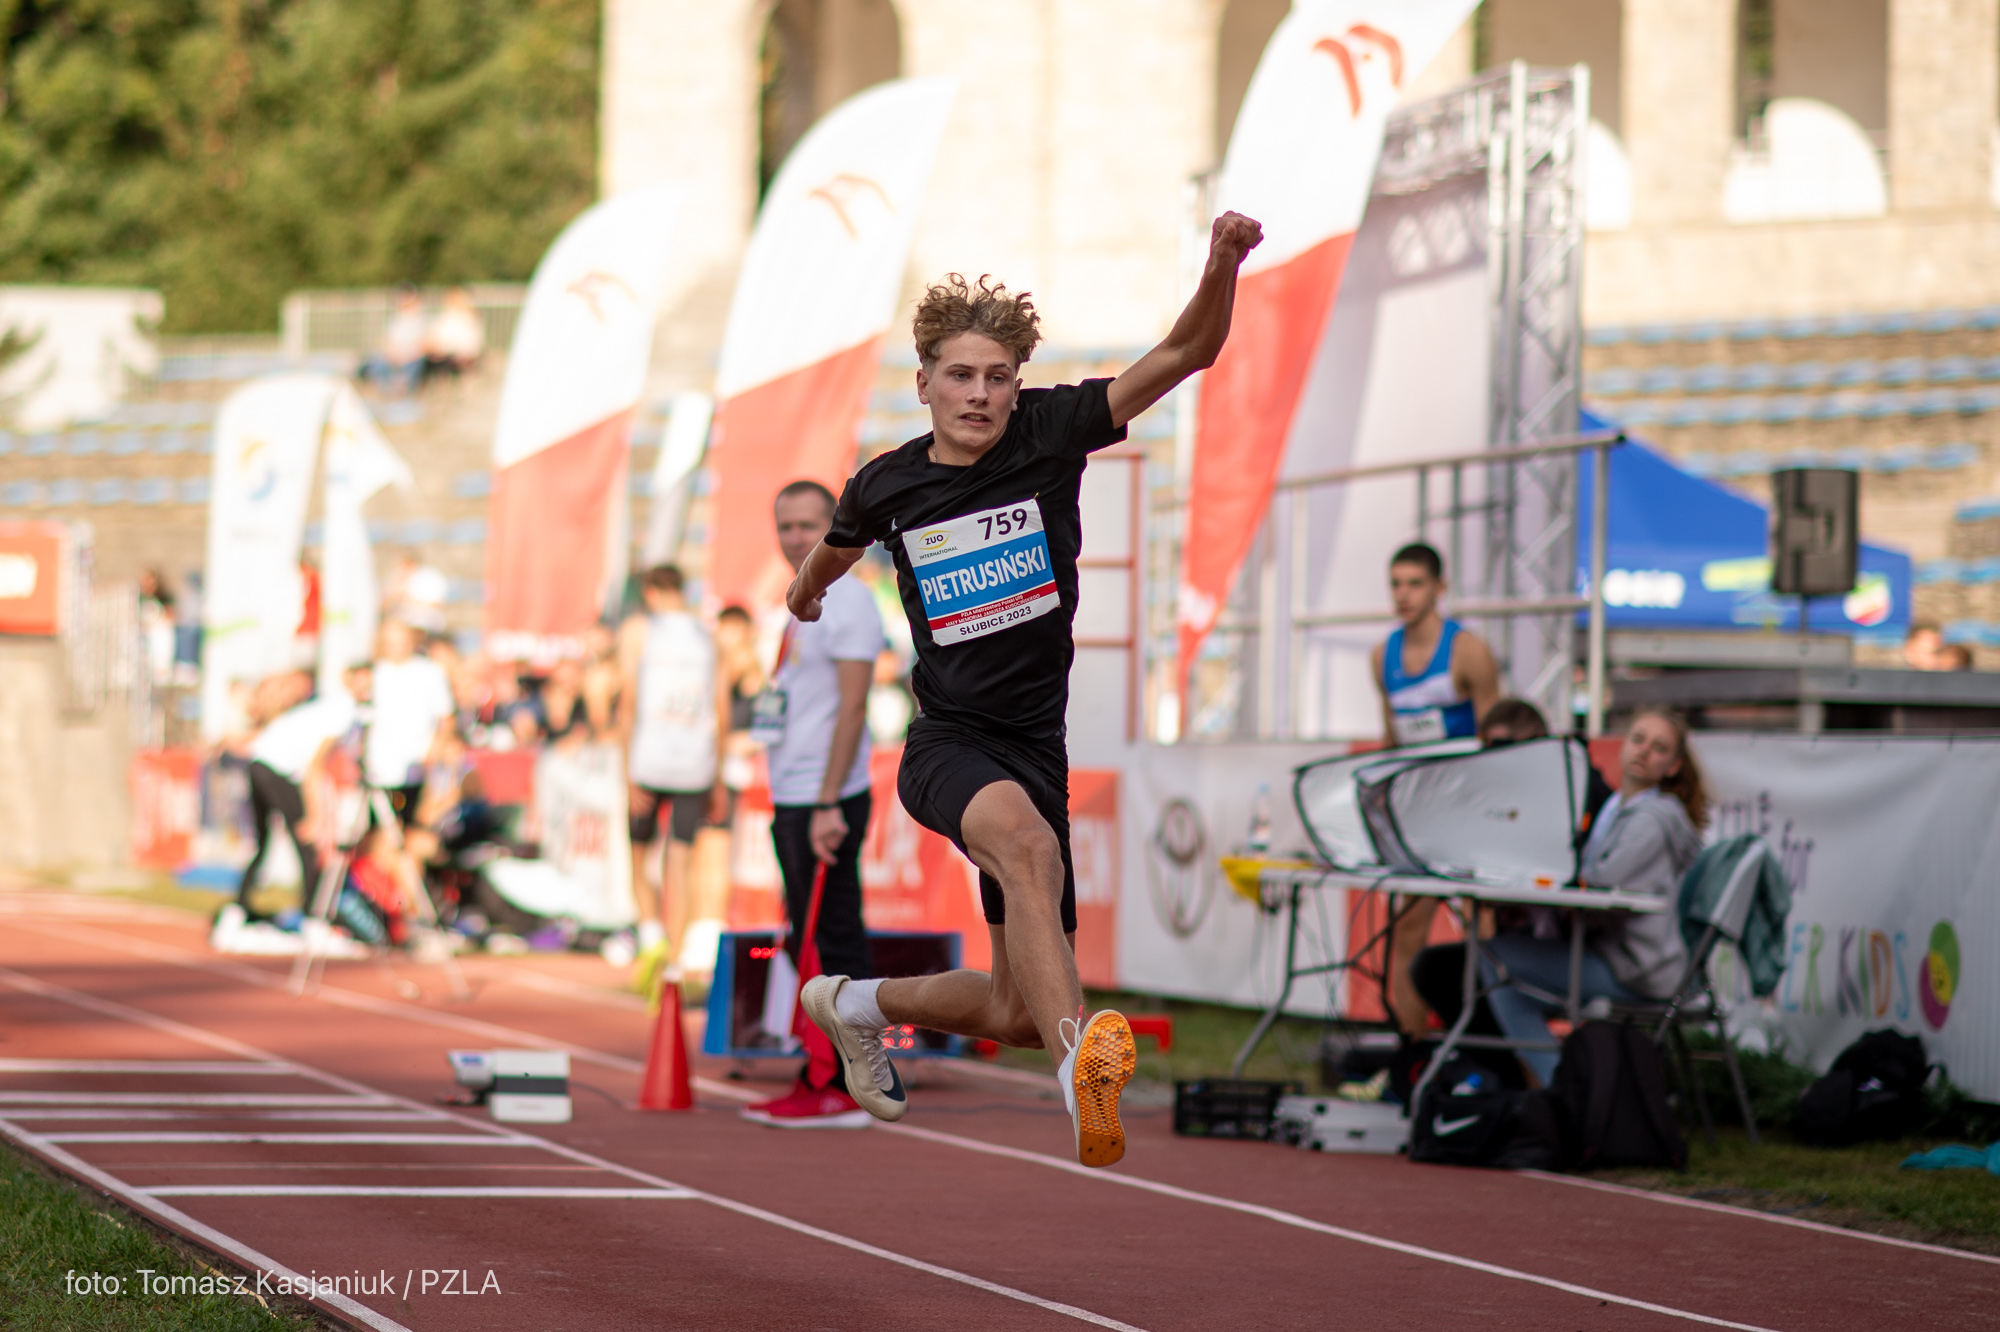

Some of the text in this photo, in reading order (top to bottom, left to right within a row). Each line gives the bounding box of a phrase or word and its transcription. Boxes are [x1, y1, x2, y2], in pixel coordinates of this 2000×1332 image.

[925, 534, 944, 545] ZUO
[977, 508, 1028, 541] 759
[919, 546, 958, 560] INTERNATIONAL
[920, 545, 1047, 605] PIETRUSIŃSKI
[960, 605, 1032, 636] SŁUBICE 2023
[1836, 925, 1911, 1022] KIDS
